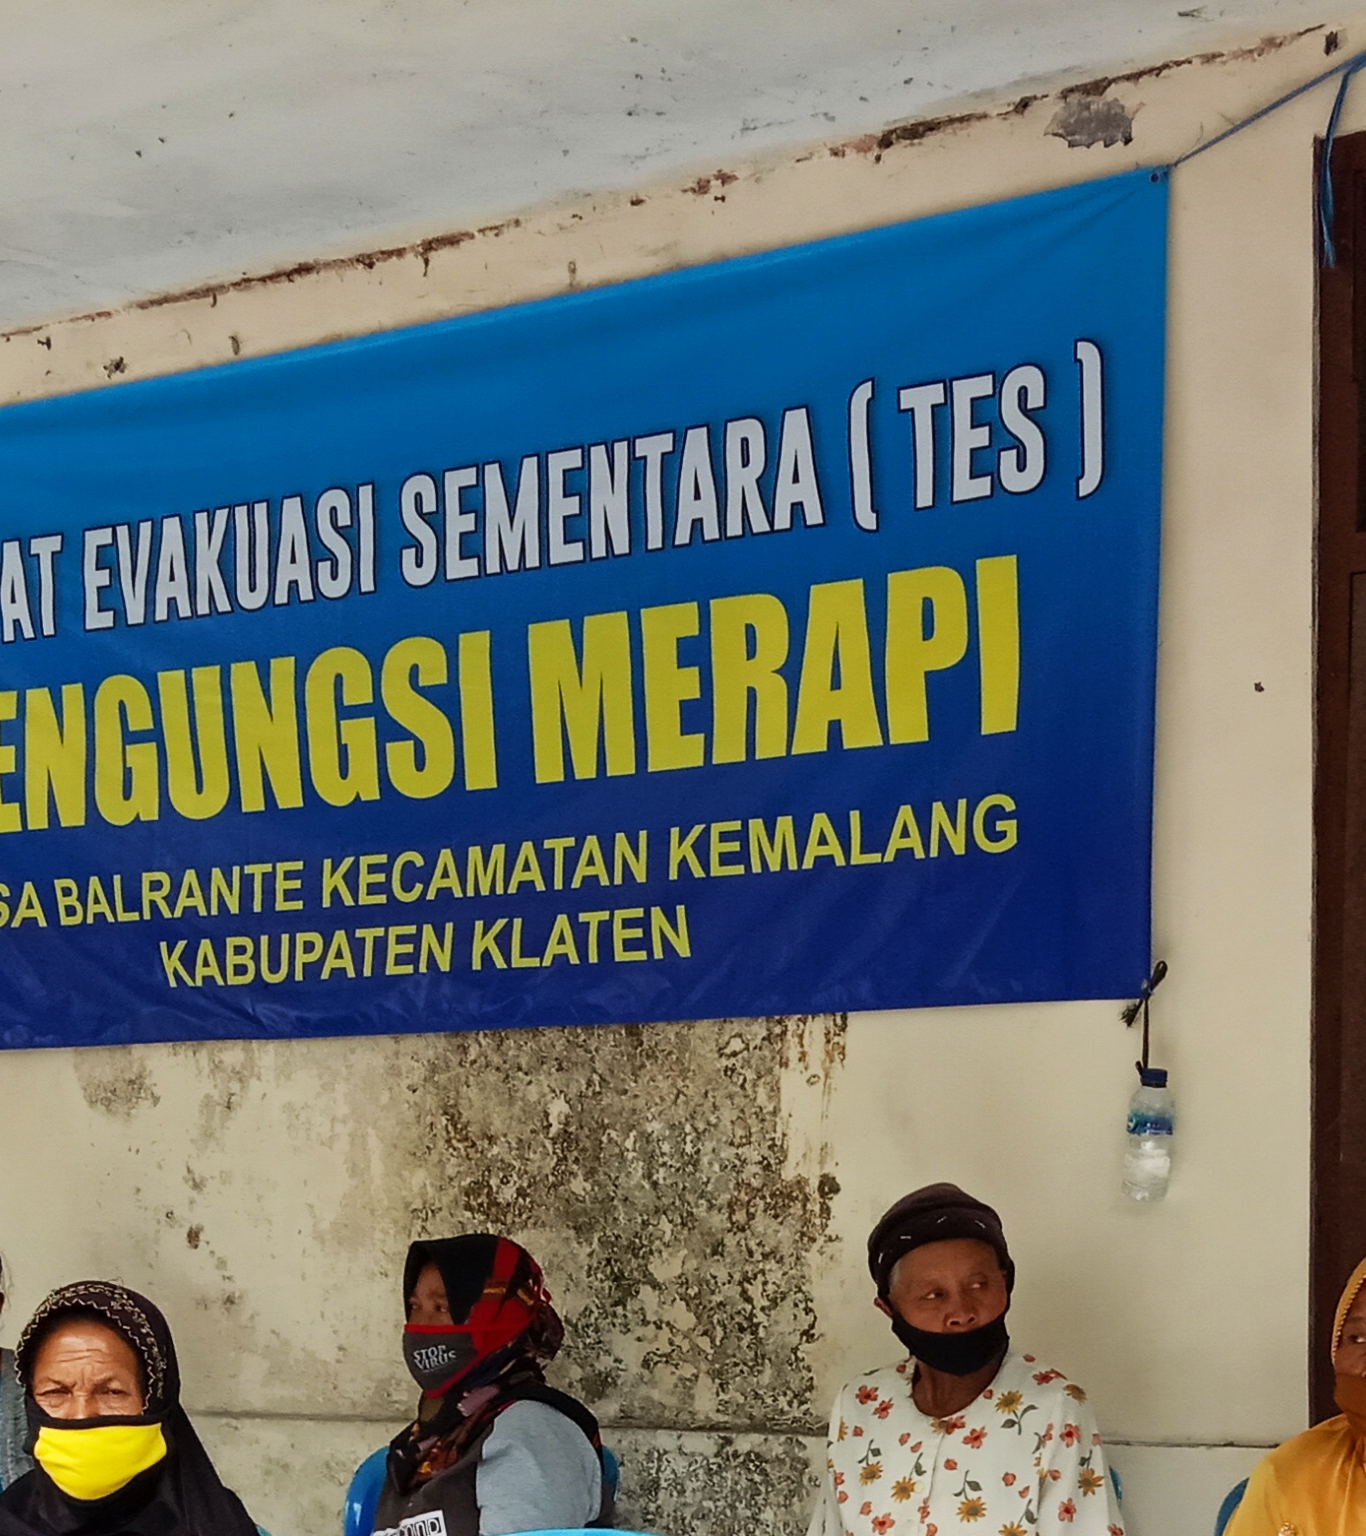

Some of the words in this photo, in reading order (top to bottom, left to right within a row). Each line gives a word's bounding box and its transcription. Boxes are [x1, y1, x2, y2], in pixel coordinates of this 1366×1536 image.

[81, 483, 376, 632] EVAKUASI
[398, 406, 825, 589] SEMENTARA
[897, 362, 1047, 511] TES
[527, 553, 1021, 785] MERAPI
[53, 860, 305, 927] BALRANTE
[321, 829, 648, 910] KECAMATAN
[668, 793, 1019, 881] KEMALANG
[159, 921, 455, 989] KABUPATEN
[471, 903, 692, 971] KLATEN
[413, 1344, 446, 1361] STOP
[414, 1350, 456, 1370] VIRUS
